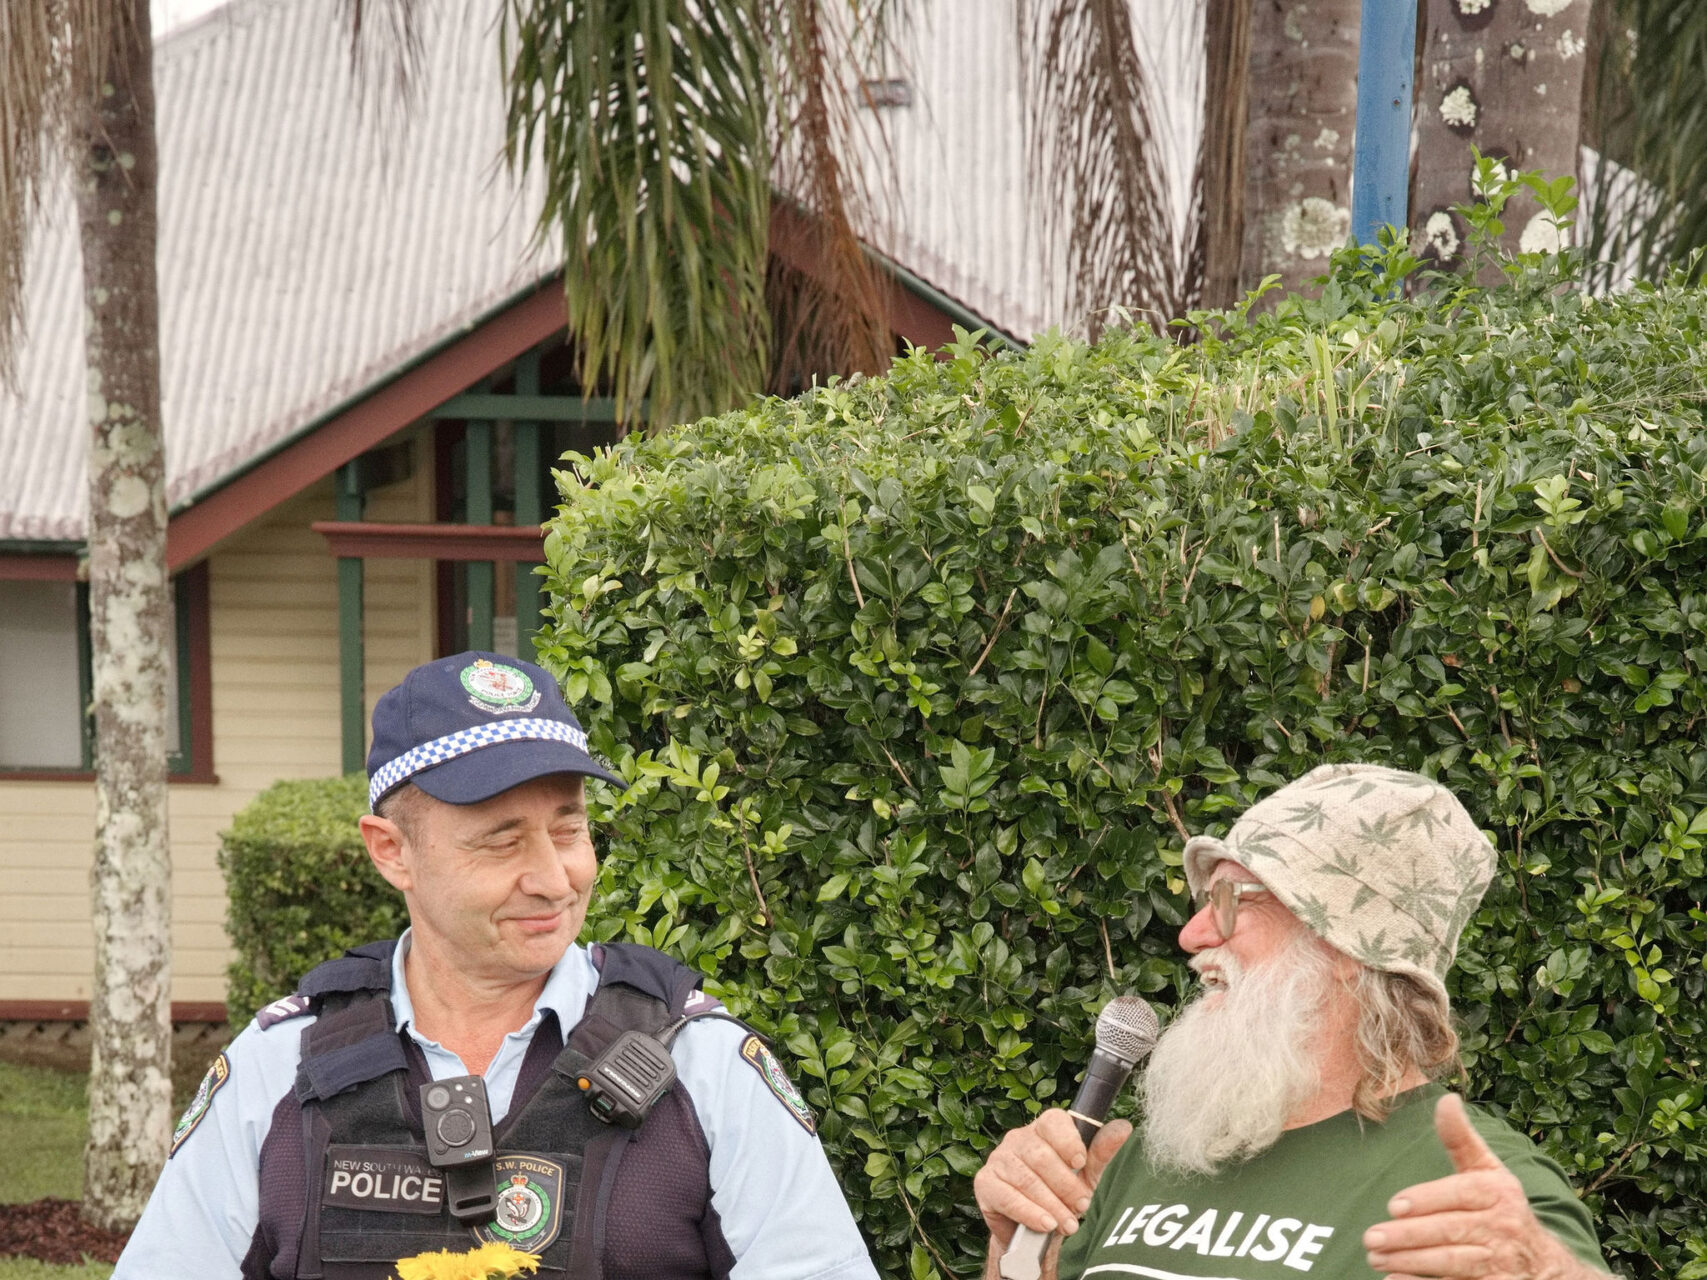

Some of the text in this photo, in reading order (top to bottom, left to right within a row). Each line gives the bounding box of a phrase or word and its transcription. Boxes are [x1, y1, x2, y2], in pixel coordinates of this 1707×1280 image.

[334, 1160, 361, 1171] NEW
[519, 1161, 555, 1177] POLICE
[330, 1171, 442, 1203] POLICE
[1102, 1203, 1335, 1272] LEGALISE
